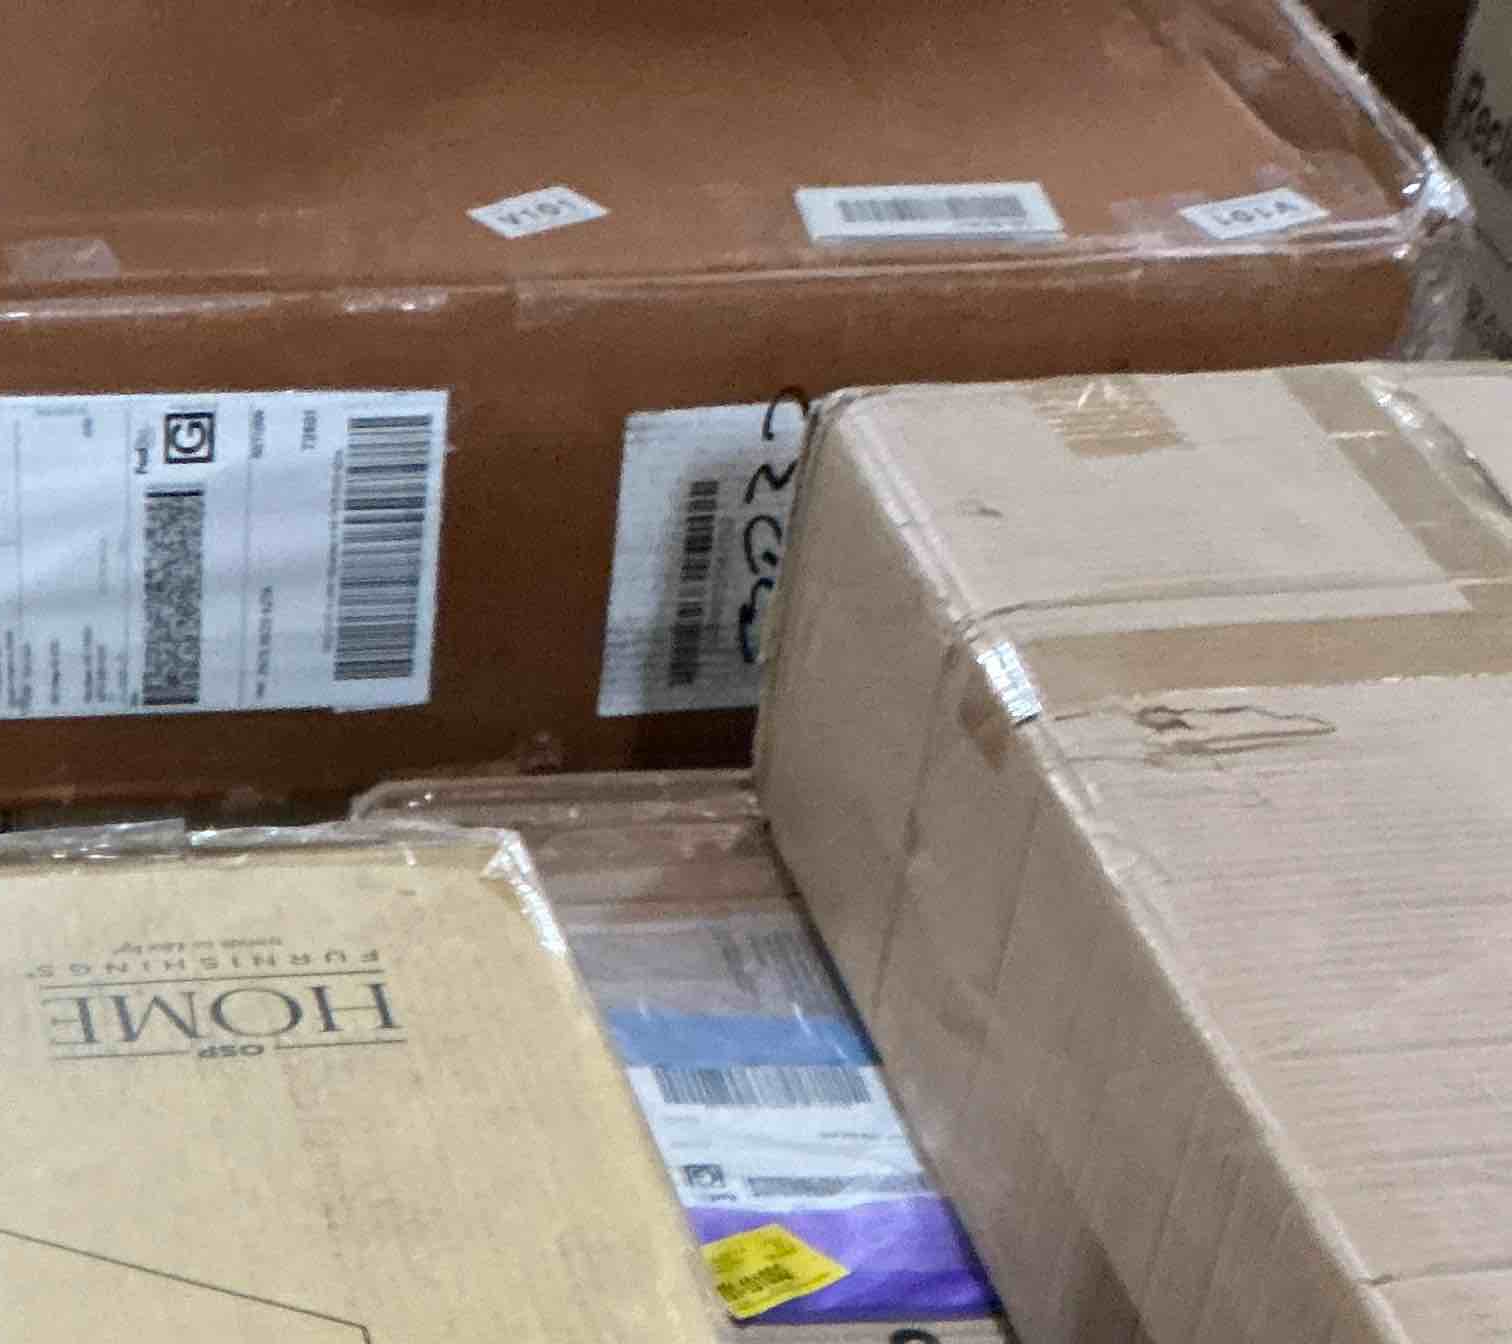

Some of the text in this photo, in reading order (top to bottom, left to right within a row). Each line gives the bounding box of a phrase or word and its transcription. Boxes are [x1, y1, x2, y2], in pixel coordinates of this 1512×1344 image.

[34, 950, 381, 978] FURNISHINGS
[39, 984, 400, 1044] HOME
[196, 1042, 265, 1060] OSP
